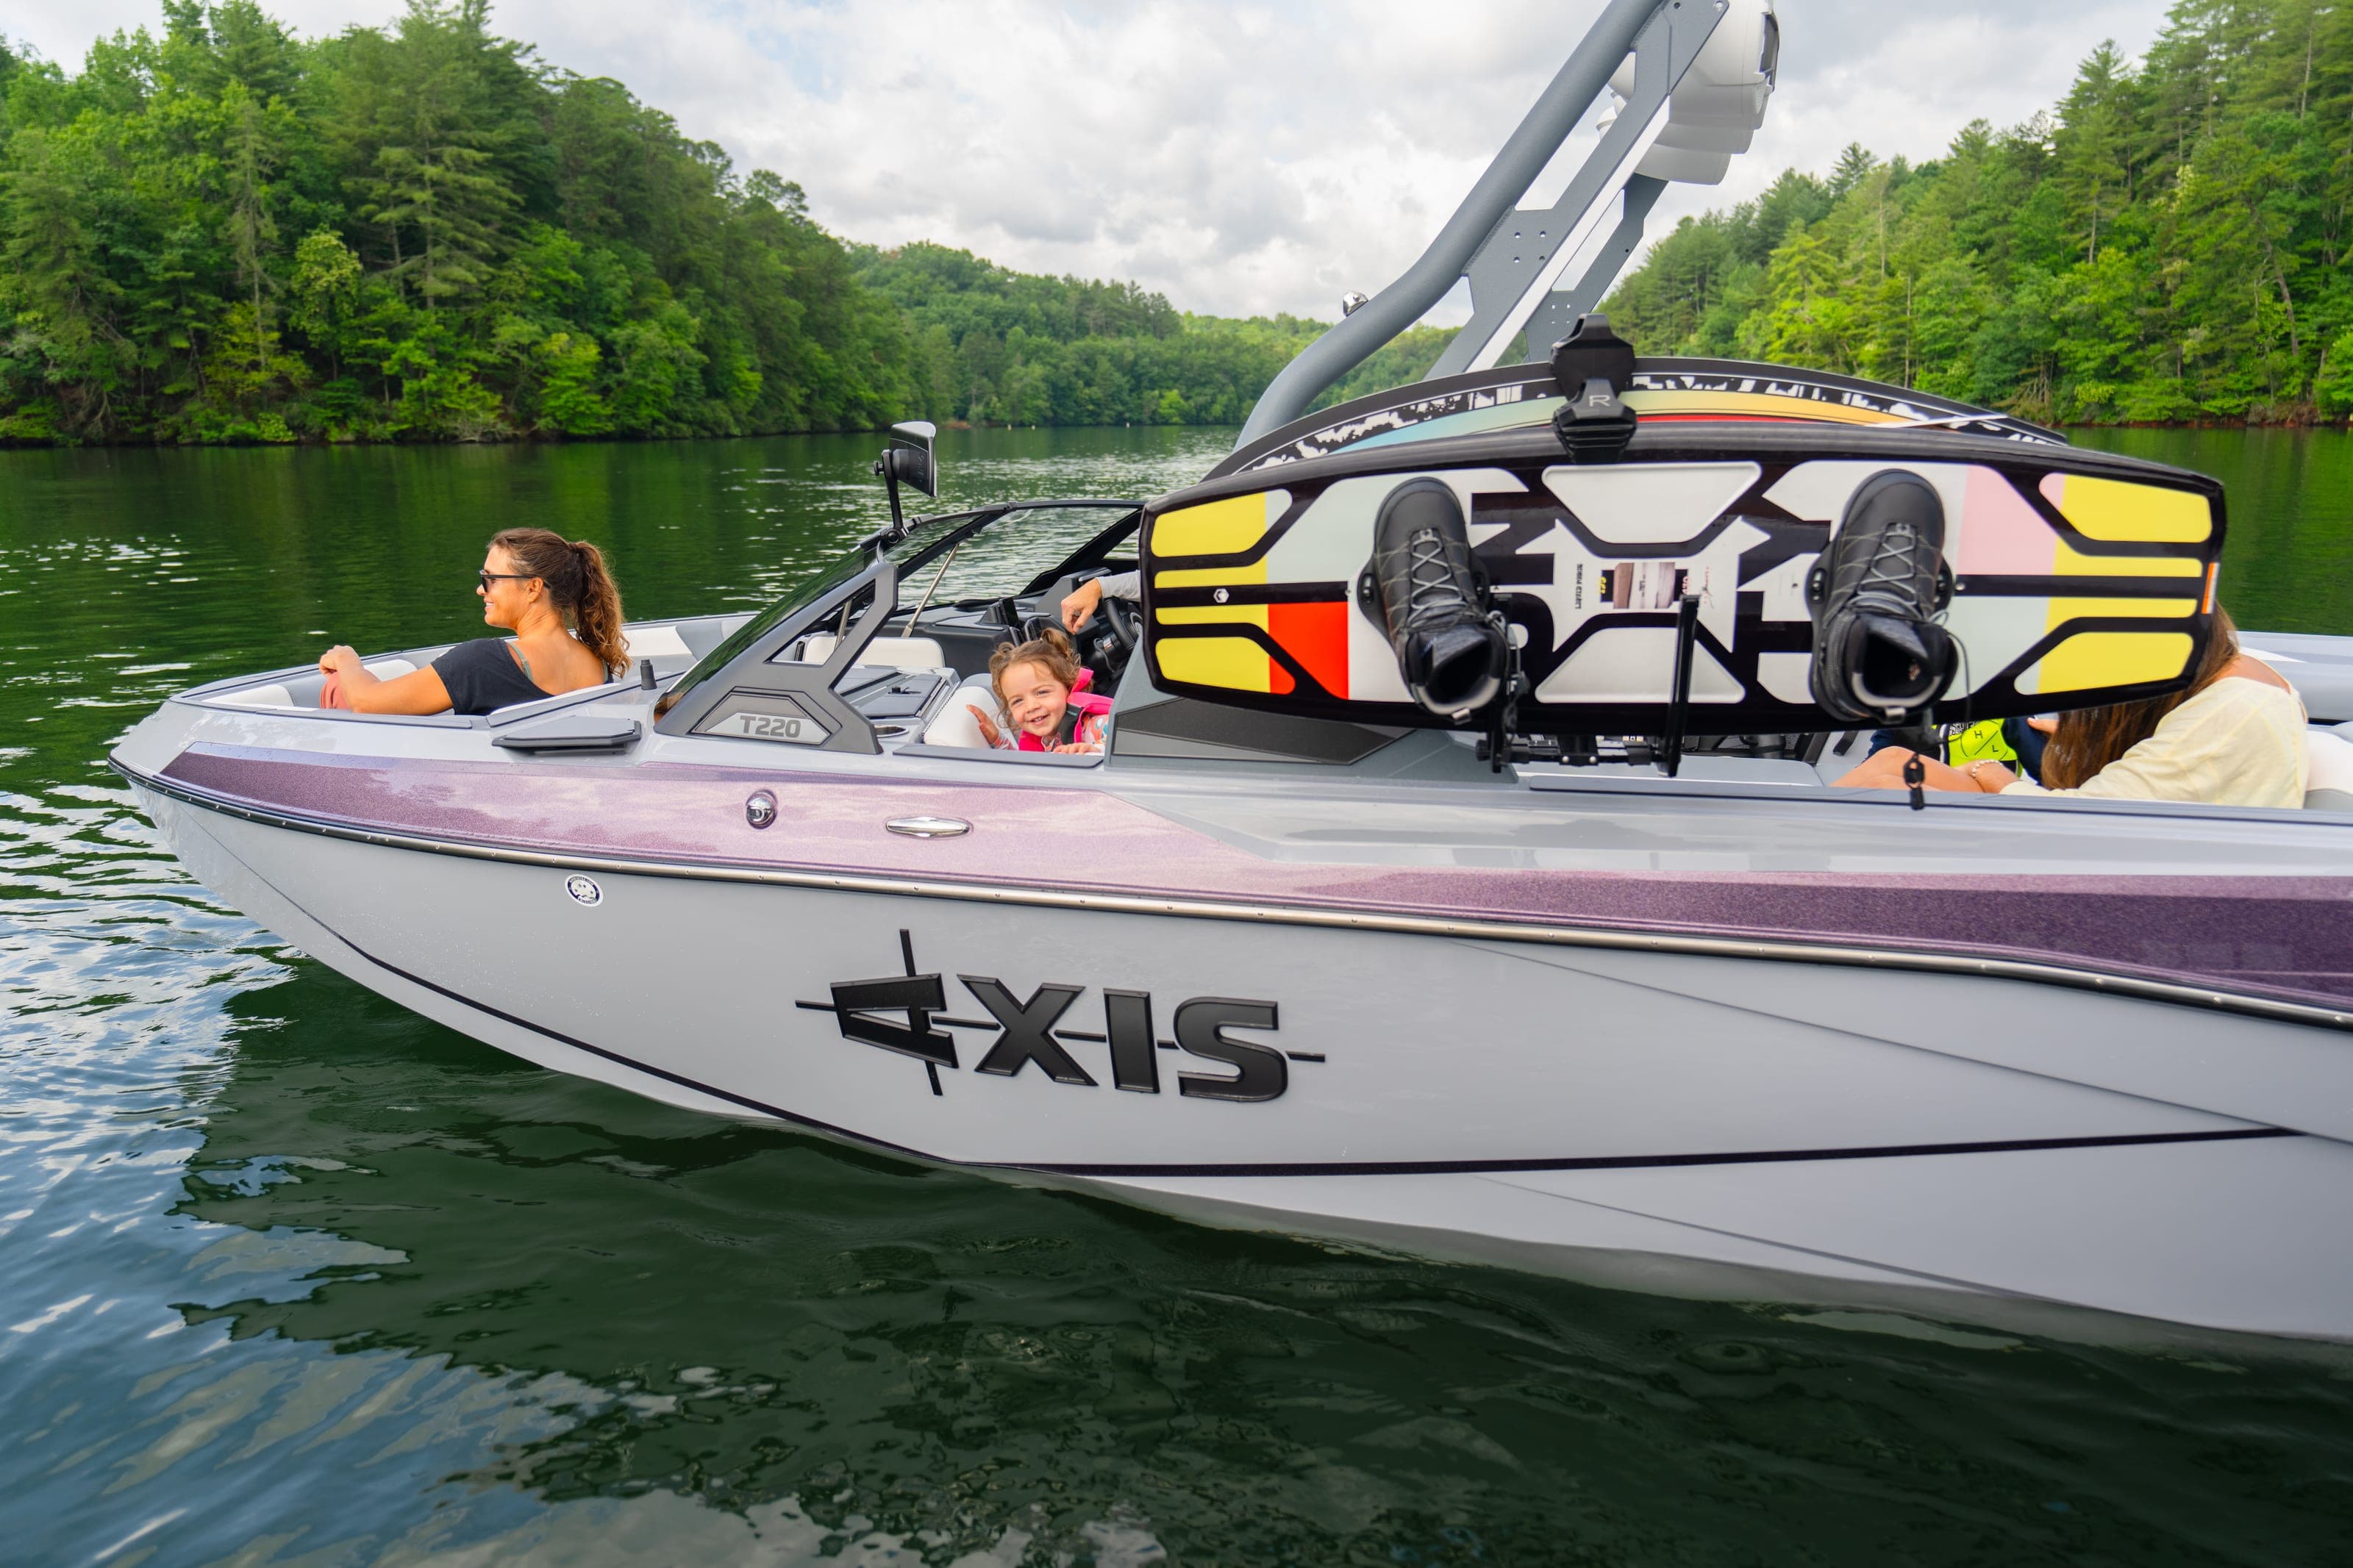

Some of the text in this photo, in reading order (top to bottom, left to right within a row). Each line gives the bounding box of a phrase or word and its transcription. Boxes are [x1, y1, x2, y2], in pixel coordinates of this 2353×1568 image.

[1589, 395, 1610, 407] R
[740, 715, 801, 738] T220
[1974, 730, 1983, 739] H
[1992, 745, 1999, 753] L
[829, 972, 1288, 1103] AXIS
